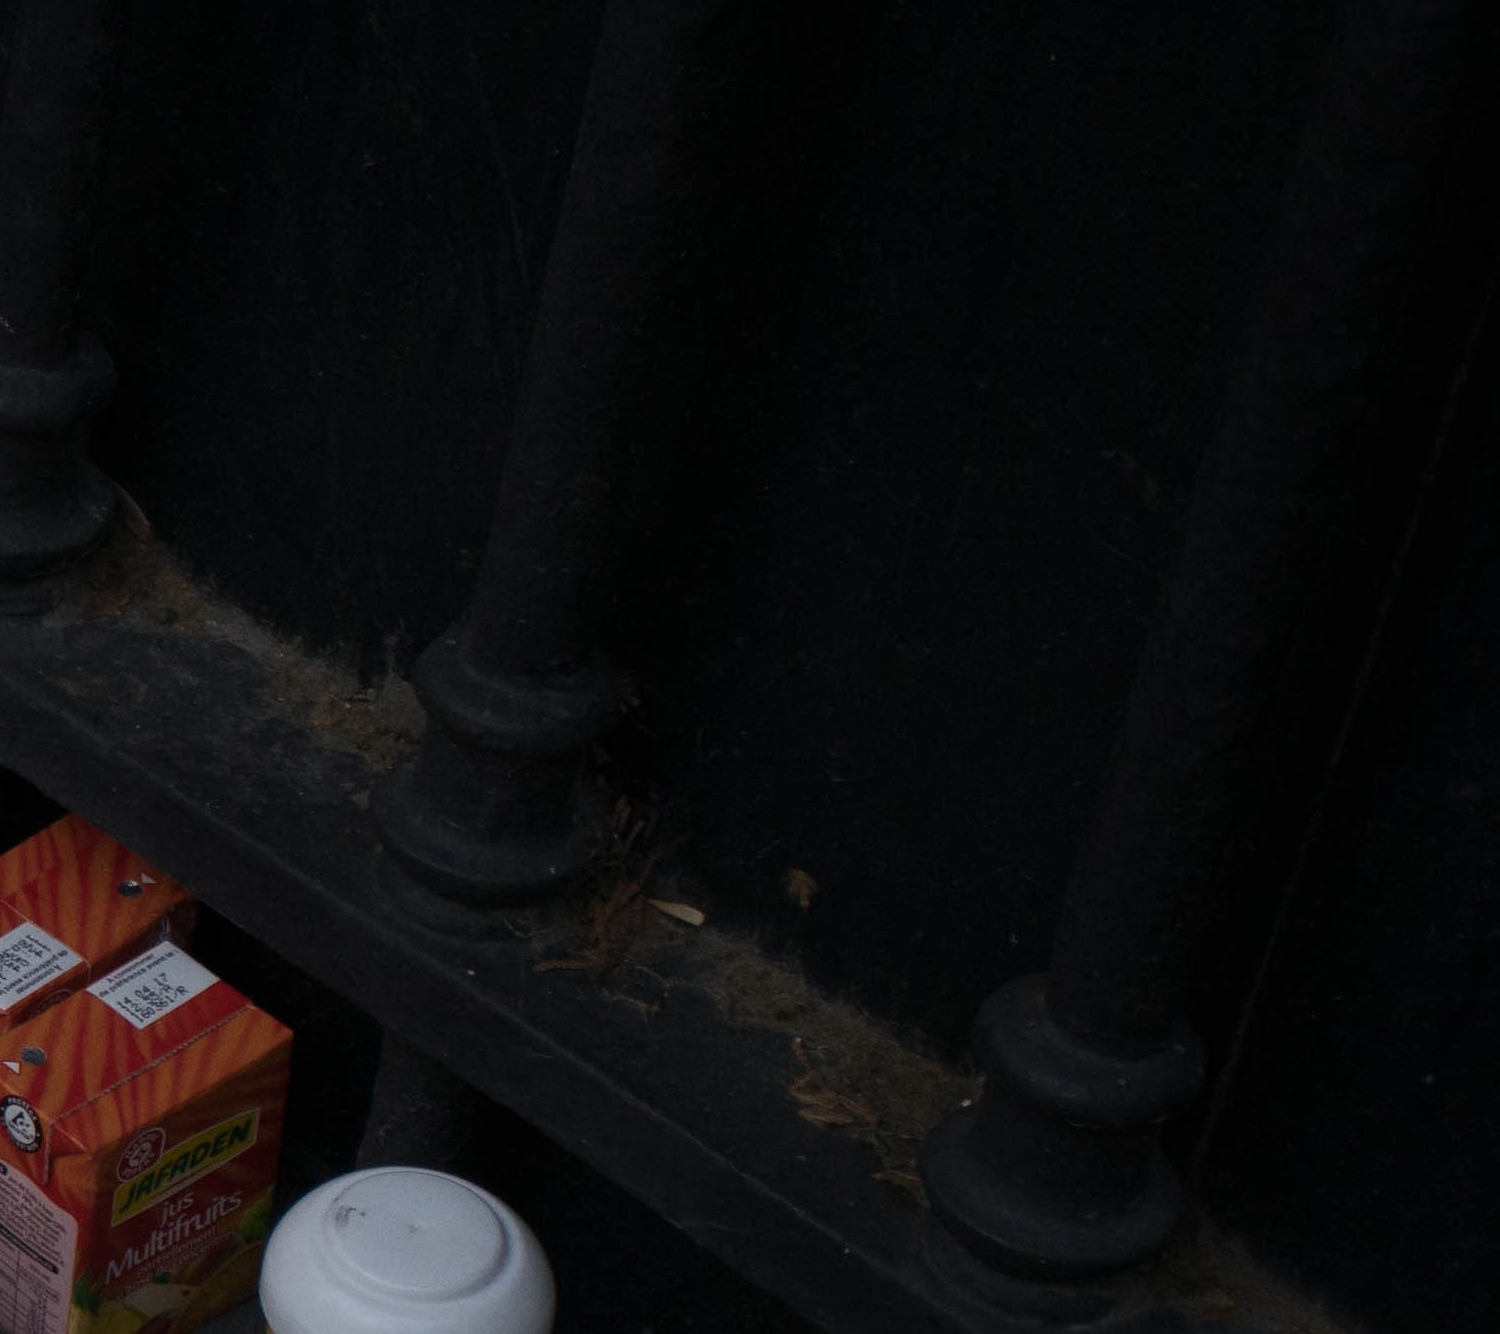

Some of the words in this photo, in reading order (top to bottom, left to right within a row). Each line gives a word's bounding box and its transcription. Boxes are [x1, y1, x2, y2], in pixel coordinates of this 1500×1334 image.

[119, 1119, 253, 1213] JAFADEN
[160, 1190, 195, 1228] jus
[105, 1187, 245, 1285] Multifruits
